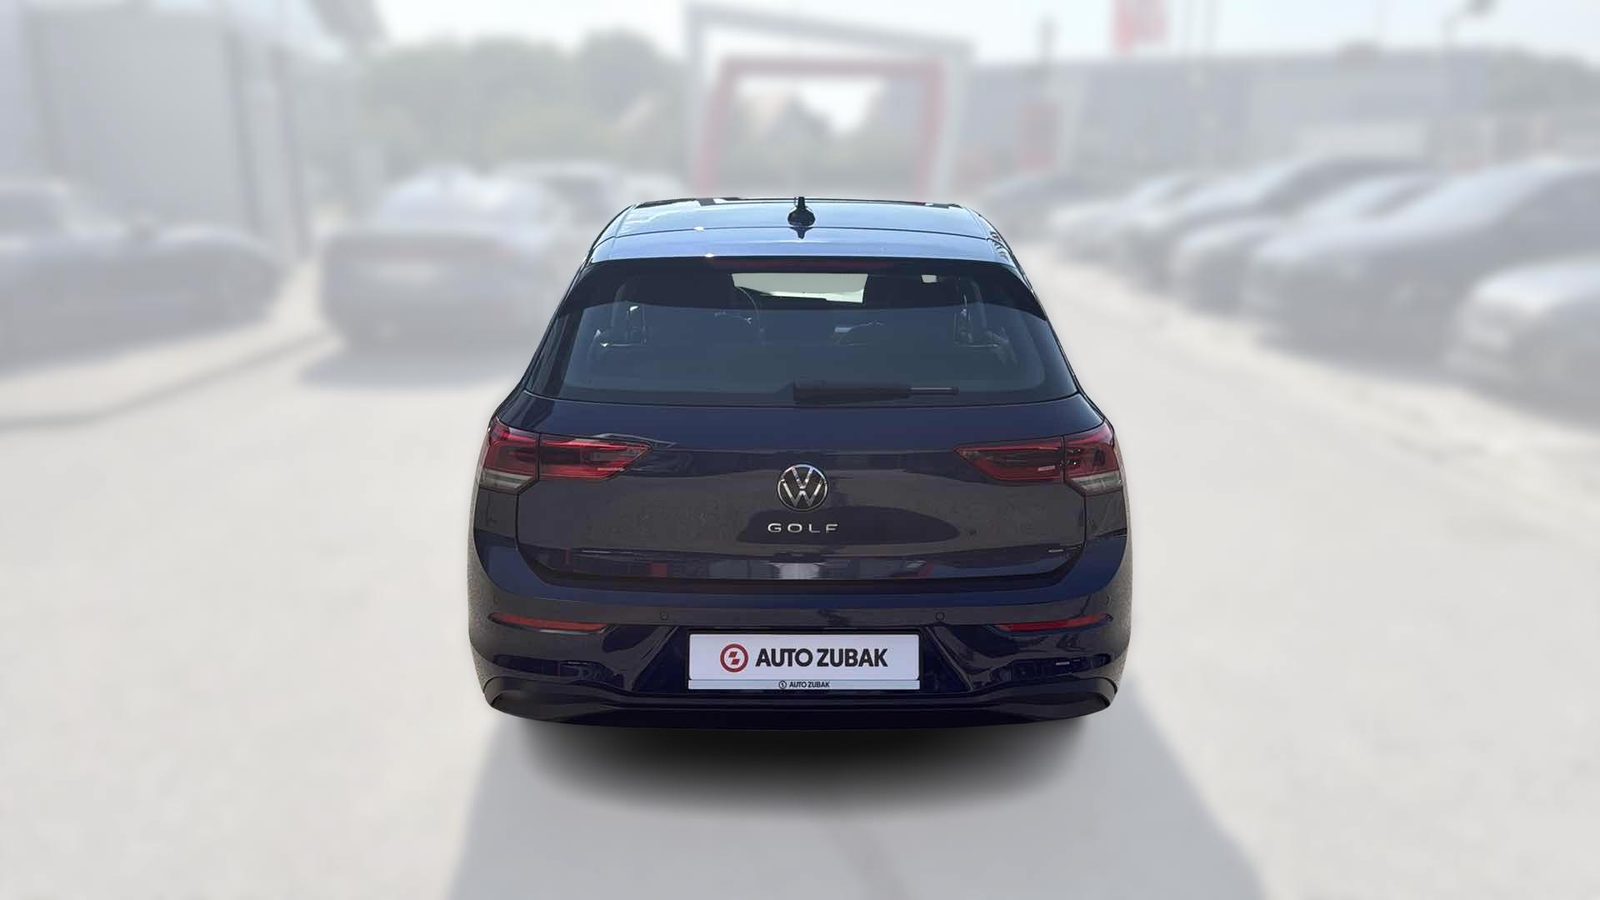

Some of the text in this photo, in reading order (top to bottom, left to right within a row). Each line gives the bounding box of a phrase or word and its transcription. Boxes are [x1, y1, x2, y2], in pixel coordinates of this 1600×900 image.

[767, 522, 839, 534] GOLF
[755, 647, 888, 668] AUTO ZUBAK
[788, 681, 830, 689] AUTO ZUBAK
